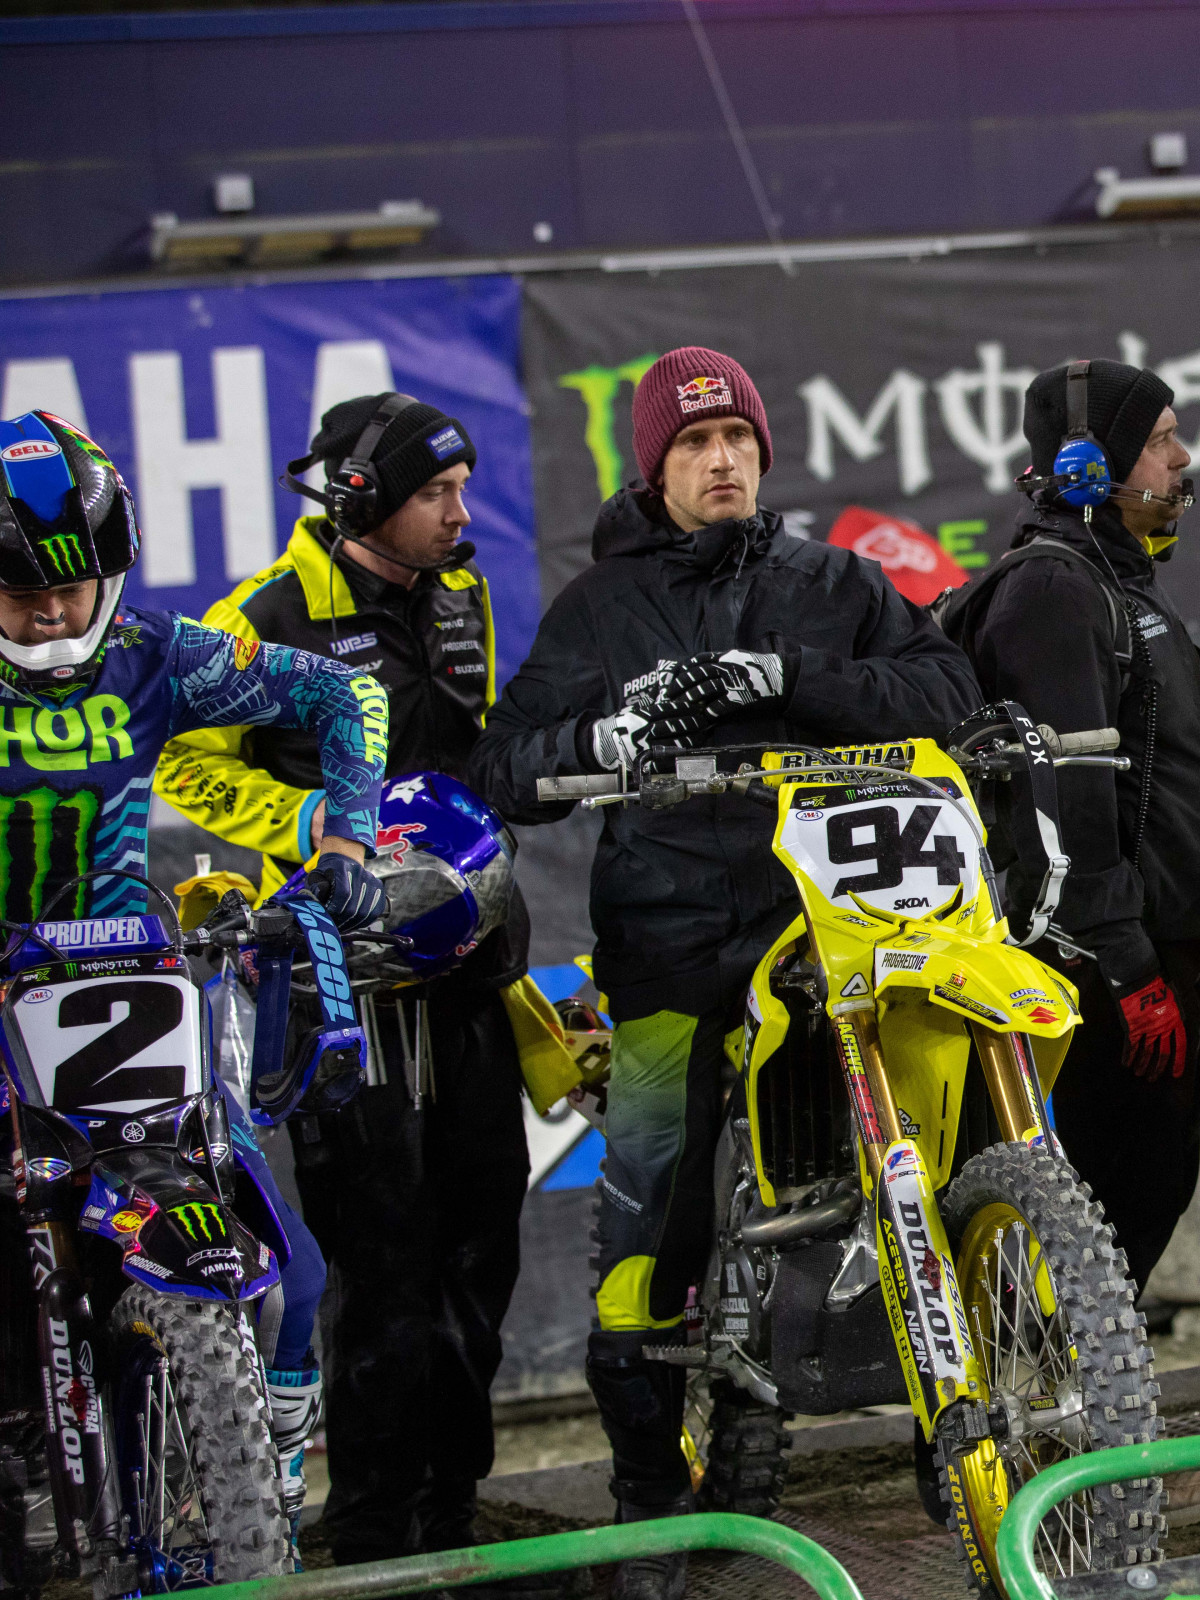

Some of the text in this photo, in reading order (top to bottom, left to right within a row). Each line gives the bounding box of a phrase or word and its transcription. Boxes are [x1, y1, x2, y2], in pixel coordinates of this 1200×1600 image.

[681, 391, 732, 412] Red Bull
[10, 444, 53, 458] BELL
[455, 664, 485, 675] SUZUKI
[350, 675, 390, 764] THOR
[1016, 716, 1049, 765] FOX
[857, 785, 911, 797] MONSTER
[826, 804, 967, 900] 94
[894, 896, 932, 911] SKDA
[43, 917, 142, 950] PROTAPER
[81, 958, 141, 972] MONSTER
[92, 969, 134, 977] ENERGY
[881, 952, 928, 971] PROGRESSIVE
[52, 980, 187, 1106] 2
[837, 1022, 865, 1076] ACTIVE
[617, 1190, 644, 1211] FUTURE
[112, 1211, 144, 1229] FMF
[126, 1254, 175, 1280] PROGRESSIVE
[201, 1262, 245, 1277] YAMAHA
[940, 1251, 975, 1361] ECSTAR
[905, 1309, 931, 1374] NISSIN
[50, 1316, 85, 1485] DUNLOP
[946, 1464, 986, 1578] DUNLOP
